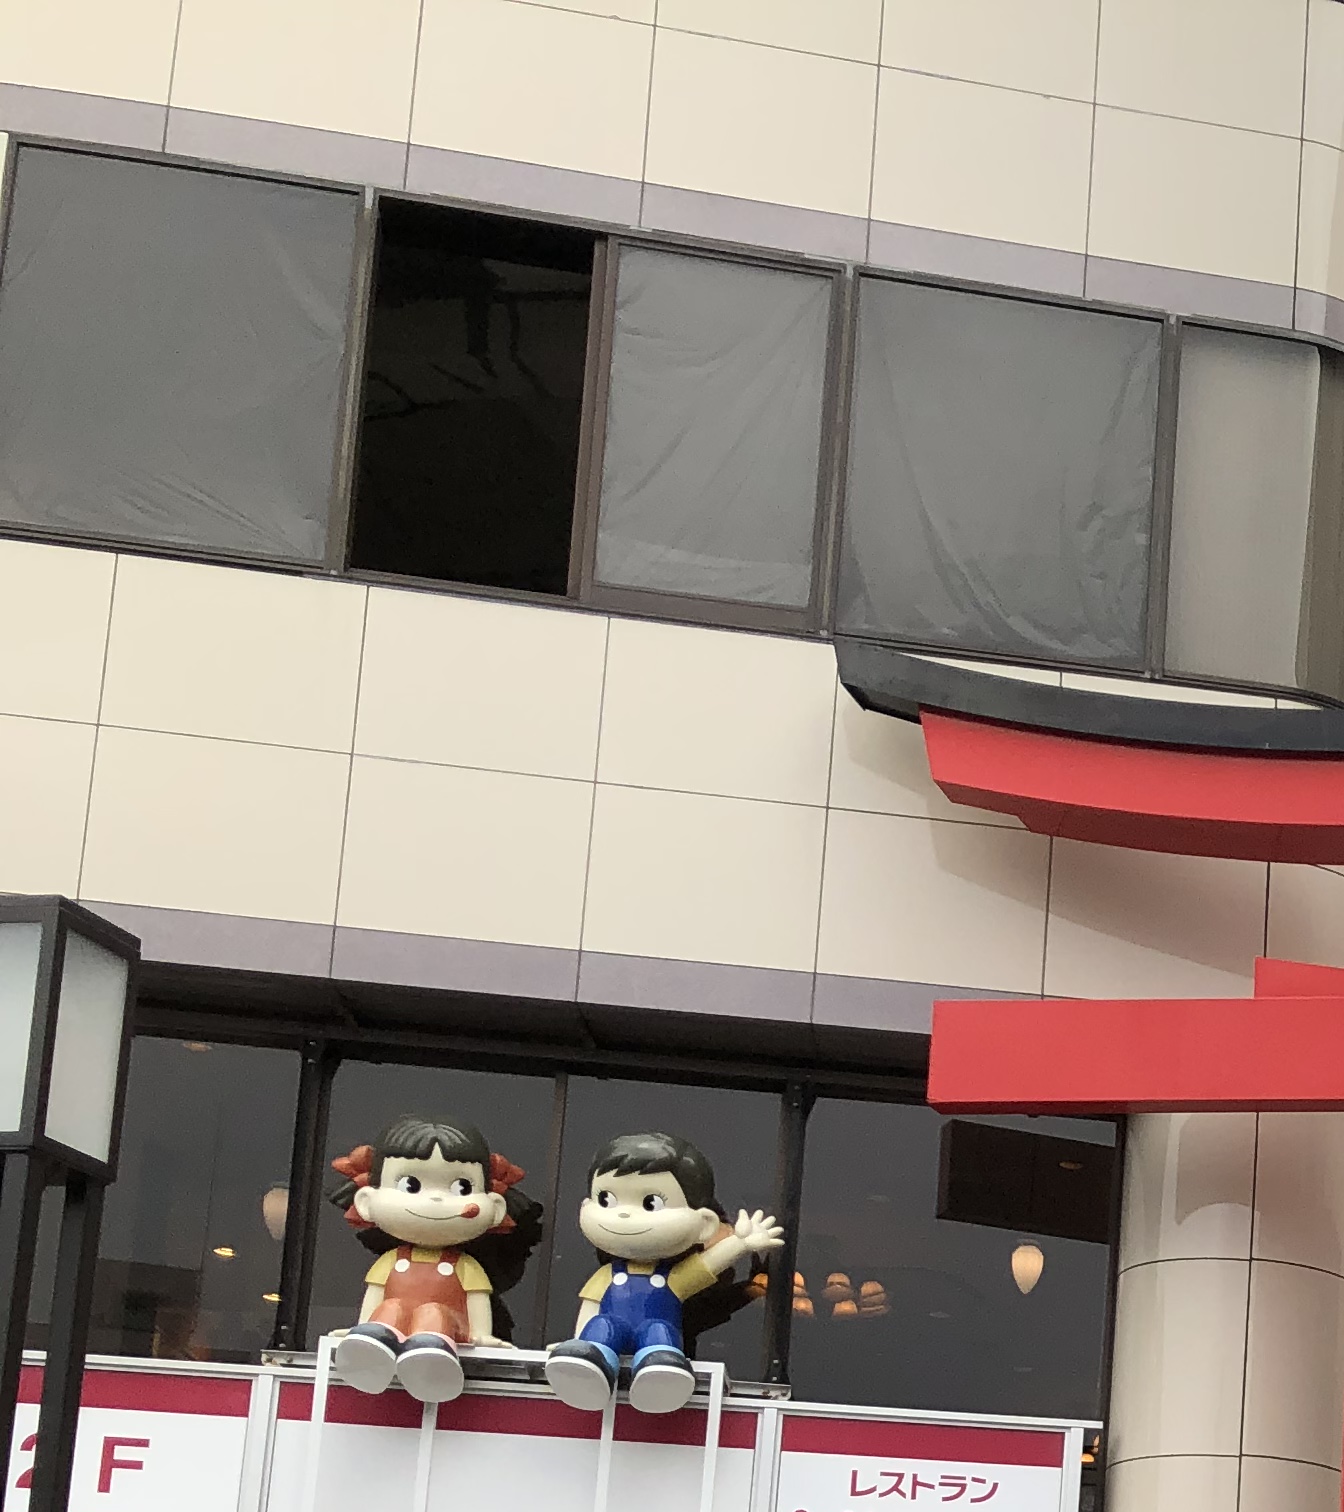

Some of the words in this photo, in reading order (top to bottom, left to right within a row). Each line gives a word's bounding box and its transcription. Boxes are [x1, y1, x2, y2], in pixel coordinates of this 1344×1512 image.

[849, 1470, 1000, 1503] レストラン
